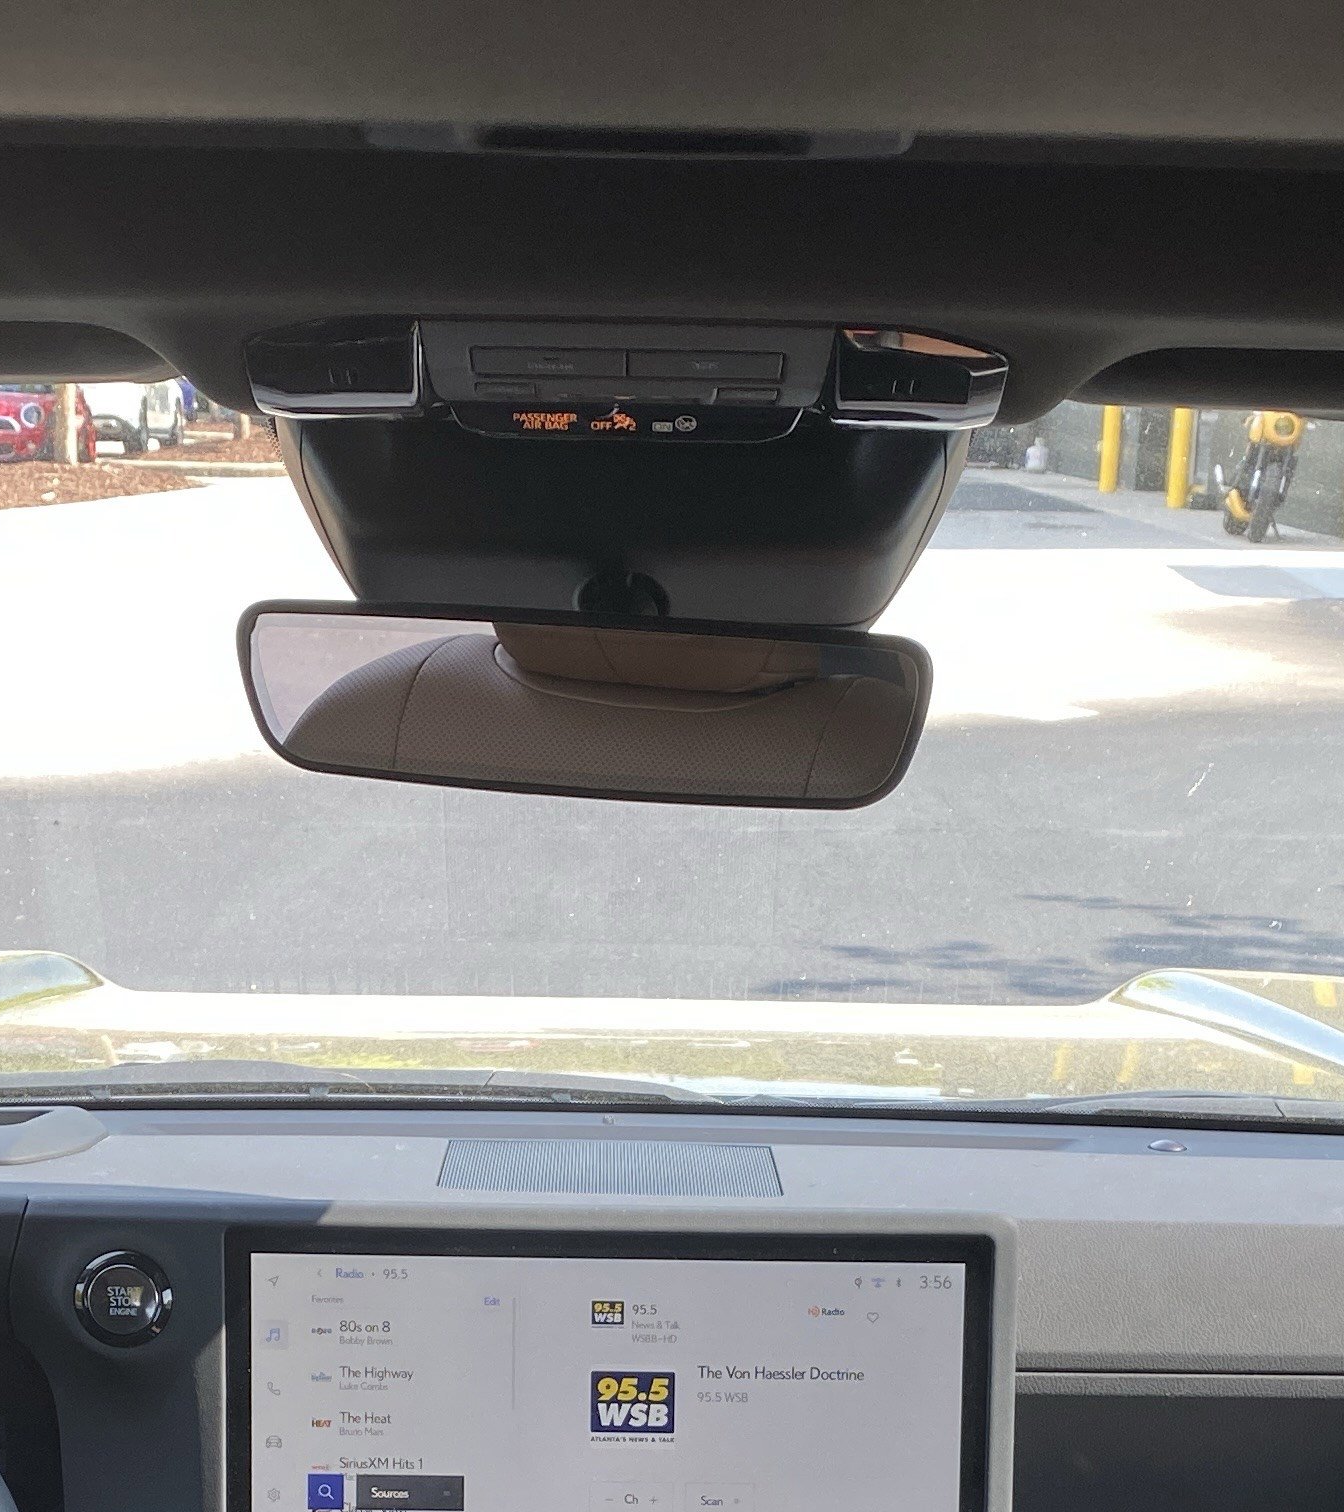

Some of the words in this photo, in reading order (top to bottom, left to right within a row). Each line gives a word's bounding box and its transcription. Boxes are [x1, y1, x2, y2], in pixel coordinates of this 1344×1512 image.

[513, 412, 578, 422] PASSENGER
[523, 421, 542, 430] AIR
[591, 422, 613, 431] OFF
[335, 1268, 364, 1279] Radio
[383, 1268, 409, 1280] 95.5
[919, 1275, 953, 1291] 3:56
[484, 1297, 501, 1306] Edit
[110, 1308, 137, 1316] ENGINE
[594, 1303, 622, 1312] 95.5
[632, 1304, 658, 1315] 95.5
[821, 1307, 846, 1317] Radio
[594, 1313, 622, 1322] WSB
[339, 1320, 362, 1332] 80s
[365, 1324, 379, 1332] on
[382, 1320, 391, 1332] 8
[339, 1336, 364, 1346] Bobby
[367, 1336, 394, 1345] Brown
[339, 1366, 361, 1378] The
[364, 1366, 414, 1381] Highway
[697, 1365, 723, 1380] The
[726, 1366, 750, 1380] Von
[755, 1366, 806, 1381] Haessler
[810, 1367, 865, 1381] Doctrine
[339, 1382, 359, 1391] Luke
[597, 1377, 669, 1401] 95.5
[697, 1392, 723, 1403] 95.5
[724, 1392, 749, 1403] WSB
[339, 1412, 361, 1424] The
[364, 1412, 392, 1424] Heat
[597, 1403, 669, 1427] WSB
[339, 1427, 365, 1436] Bruno
[365, 1427, 384, 1436] Mars
[339, 1457, 389, 1470] SiriusXM
[392, 1458, 416, 1470] Hits
[419, 1458, 424, 1470] 1
[371, 1488, 410, 1499] Sources
[624, 1494, 639, 1505] Ch
[701, 1495, 724, 1507] Scan
